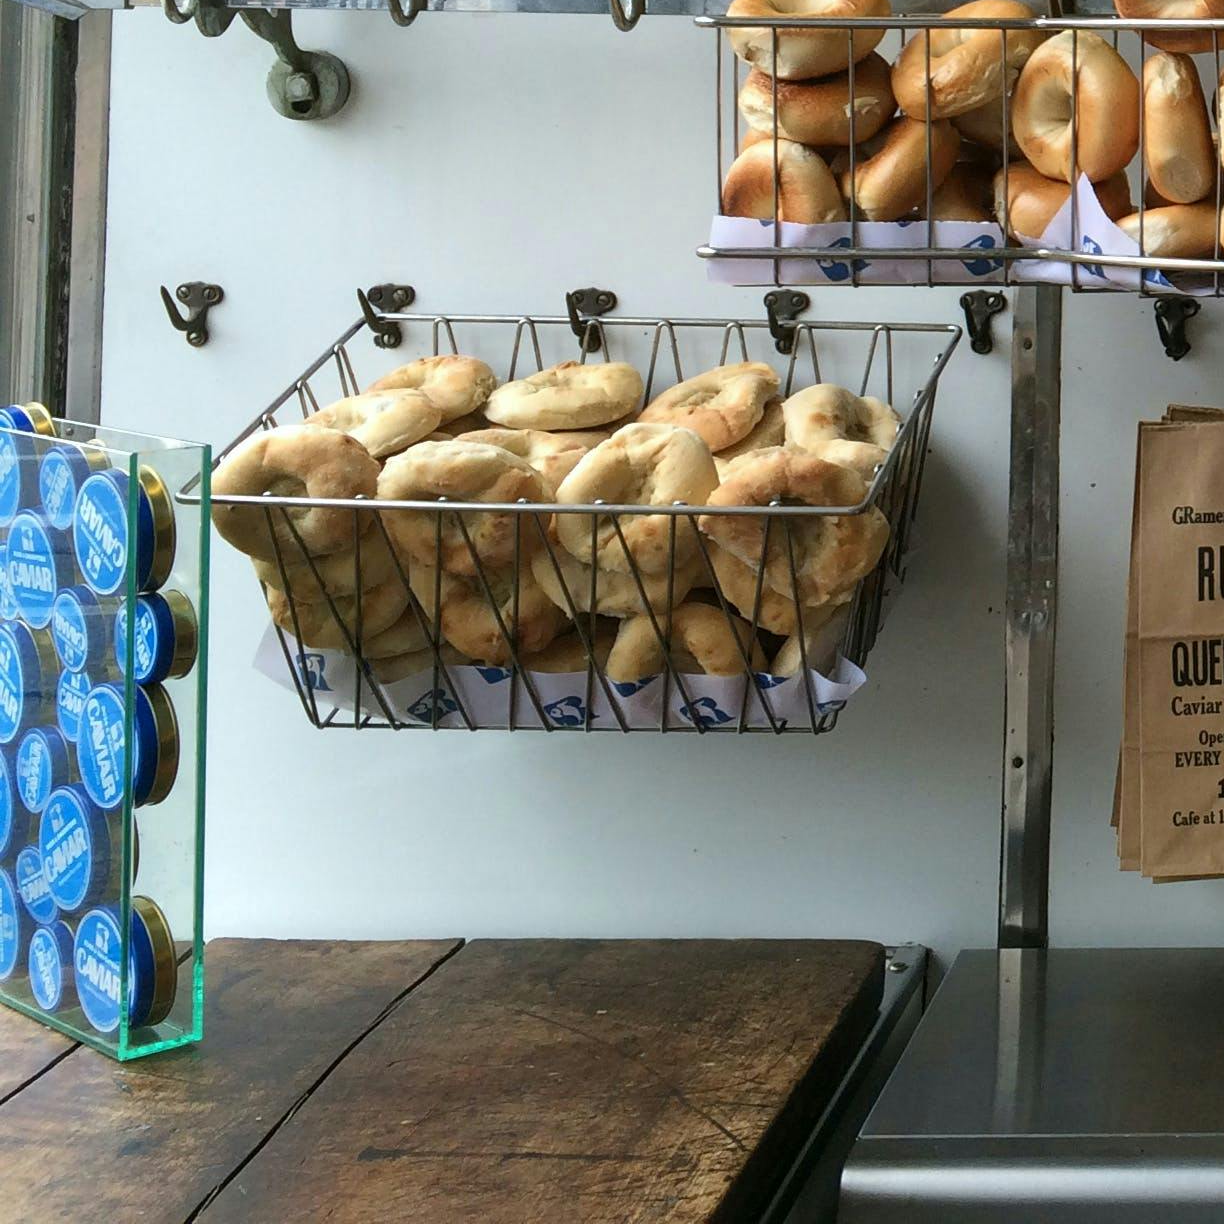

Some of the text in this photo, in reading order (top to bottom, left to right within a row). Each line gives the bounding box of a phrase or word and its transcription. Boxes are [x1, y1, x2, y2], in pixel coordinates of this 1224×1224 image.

[79, 492, 124, 568] CAVIAR
[10, 560, 54, 593] CAVIAR
[86, 697, 118, 802] CAVIAR
[1175, 750, 1221, 768] EVERY
[1173, 810, 1200, 827] Cafe
[1204, 811, 1215, 825] at
[43, 826, 88, 883] CAVIAR
